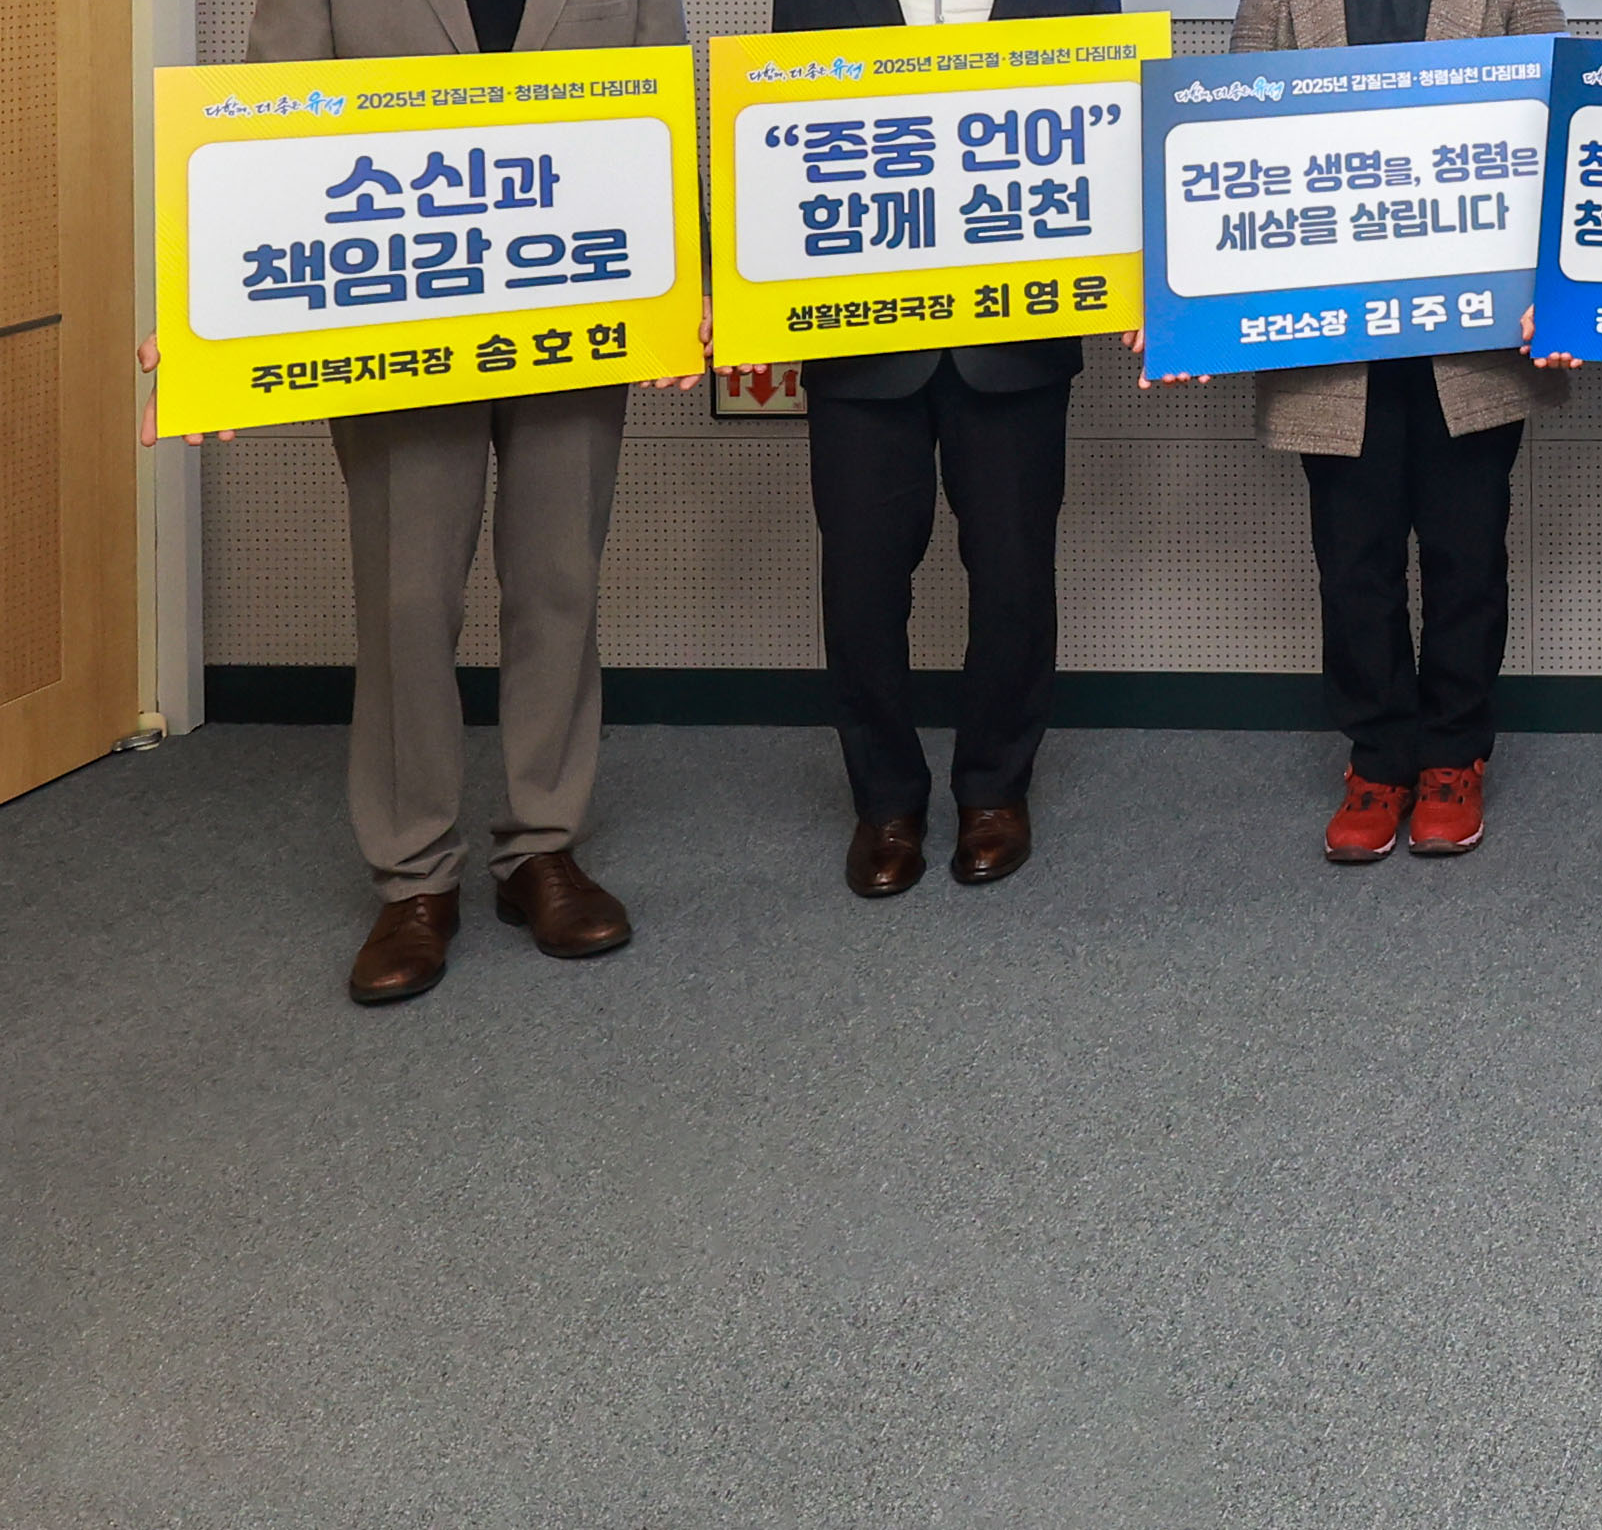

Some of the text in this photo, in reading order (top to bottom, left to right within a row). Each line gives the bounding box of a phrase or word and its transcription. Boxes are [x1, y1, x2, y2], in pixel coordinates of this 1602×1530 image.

[873, 57, 931, 75] 2025년
[1076, 44, 1137, 62] 다짐대회
[1292, 76, 1348, 96] 2025년
[1482, 64, 1540, 81] 다짐대회
[357, 92, 426, 111] 2025년
[590, 79, 658, 96] 다짐대회
[325, 148, 560, 224] 소신과
[1182, 140, 1539, 202] 건강은 생명을, 청렴은
[799, 176, 1092, 256] 함께 실천
[1216, 191, 1510, 251] 세상을 살립니다
[786, 294, 954, 332] 생활환경국장
[1239, 310, 1347, 344] 보건소장
[250, 345, 453, 393] 주민복지국장
